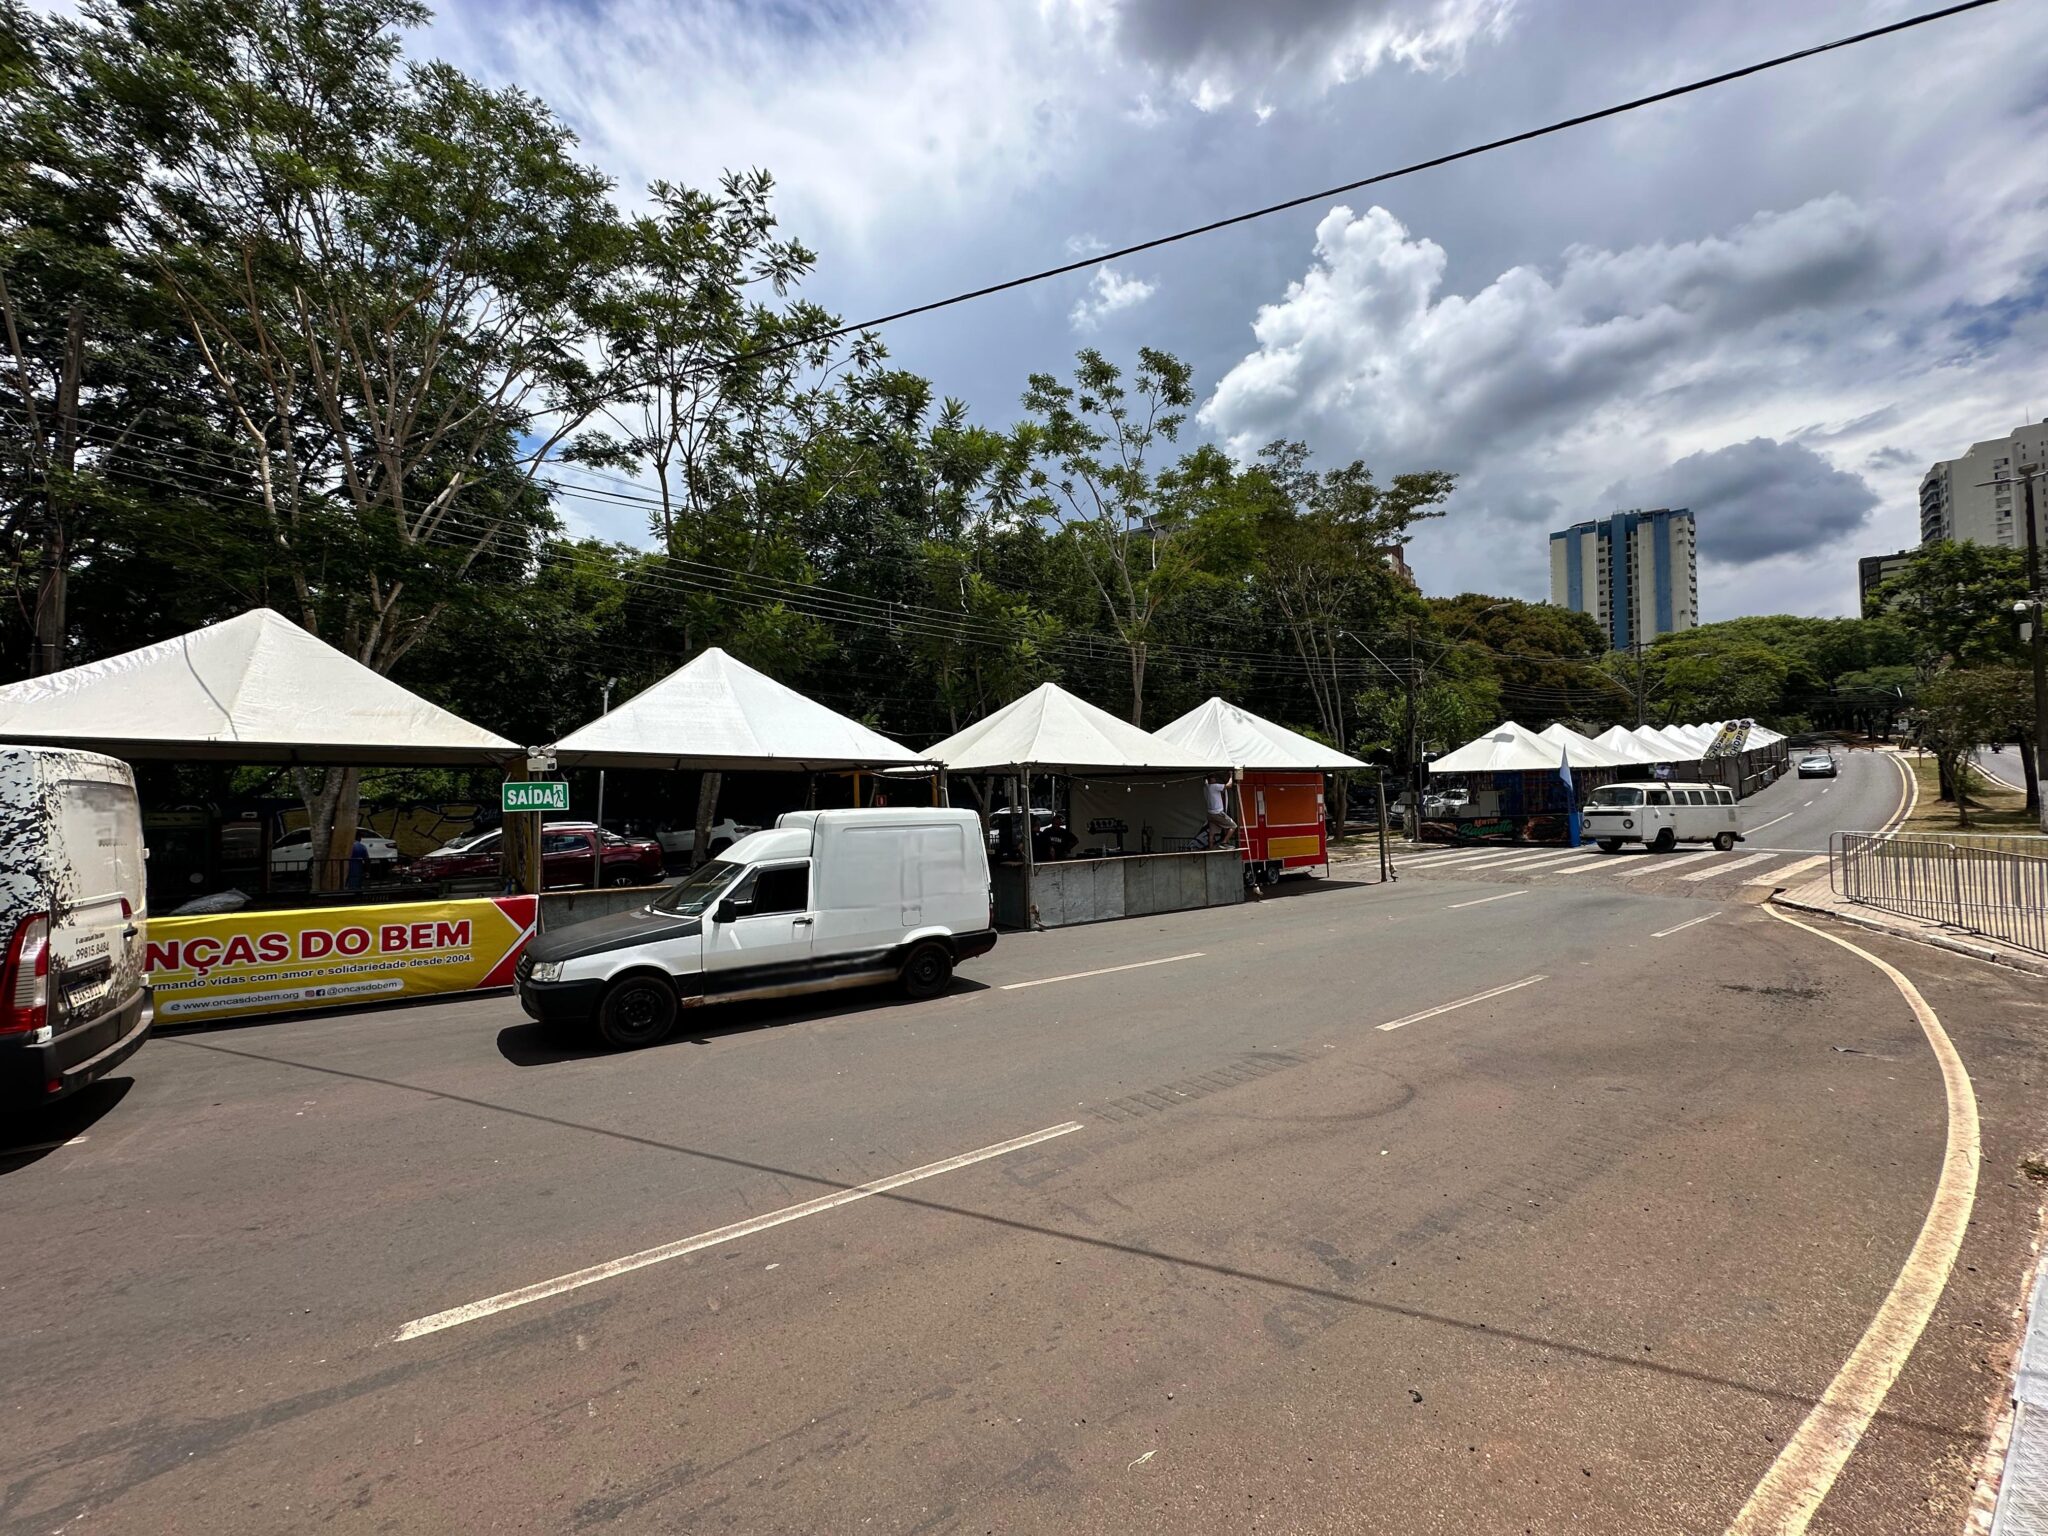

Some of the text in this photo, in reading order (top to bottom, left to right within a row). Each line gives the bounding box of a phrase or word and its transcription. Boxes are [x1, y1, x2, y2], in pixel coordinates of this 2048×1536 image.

[1729, 730, 1744, 757] CHOPP
[507, 785, 553, 806] SAÍDA
[145, 932, 290, 976] NÇAS
[301, 926, 371, 959] DO
[381, 920, 472, 953] BEM
[152, 979, 206, 992] rmando
[210, 976, 246, 986] vidas
[250, 974, 278, 982] com
[282, 969, 313, 978] amor
[328, 961, 406, 974] solidariedade
[410, 957, 442, 967] desde
[183, 981, 398, 1011] www.oncasdobem.org @oncasdobem
